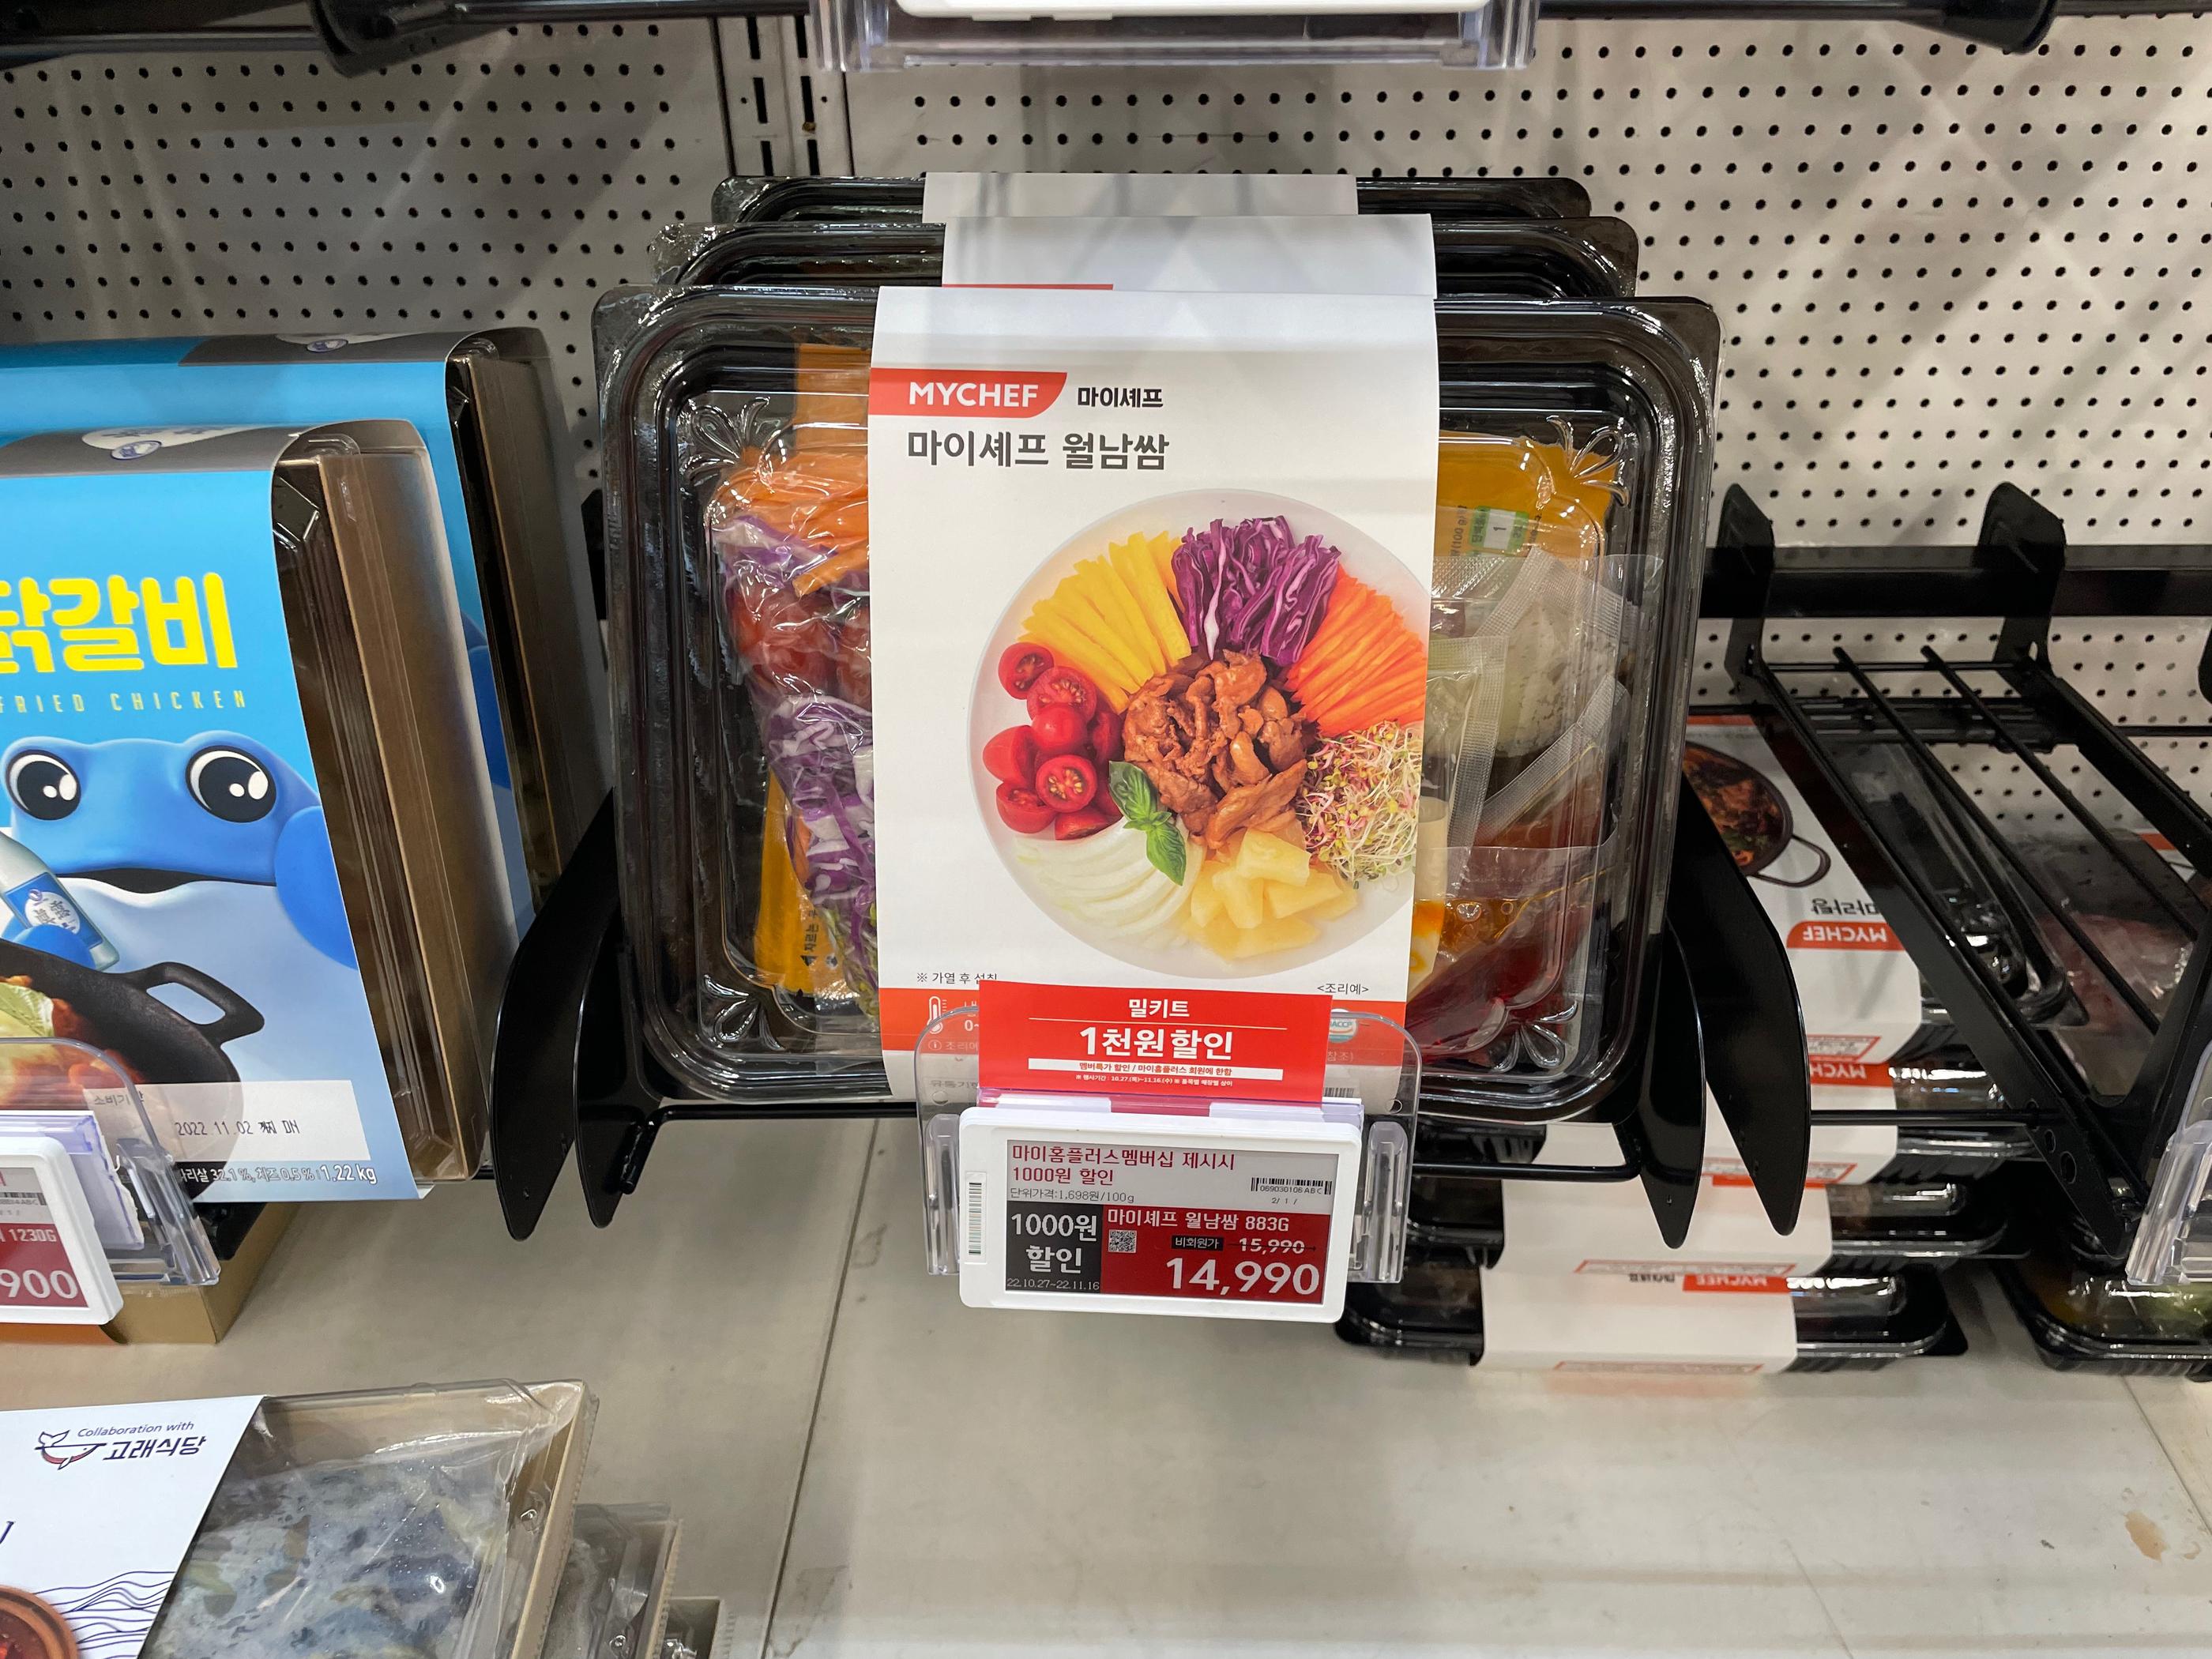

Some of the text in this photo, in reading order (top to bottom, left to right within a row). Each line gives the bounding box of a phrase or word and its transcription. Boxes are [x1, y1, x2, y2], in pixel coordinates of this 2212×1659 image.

[908, 382, 1039, 408] MYCHEF
[1078, 386, 1164, 408] 마이셰프
[908, 429, 1171, 471] 마이셰프 월남쌈
[110, 690, 246, 711] CHICKEN
[1803, 925, 1887, 942] MYCHEF
[932, 972, 955, 984] 가열
[960, 973, 971, 984] 후
[1317, 983, 1369, 995] <조리예>
[1128, 999, 1191, 1018] 밀키트
[1079, 1027, 1232, 1059] 1천원 할인
[1115, 1063, 1130, 1073] 할인
[1138, 1064, 1187, 1074] 마이홈플러스
[1810, 1063, 1867, 1078] MYCH
[1012, 1145, 1236, 1171] 마이홈플러스멤버십 제시시
[321, 1164, 356, 1182] 1.22
[356, 1162, 378, 1185] kg
[1012, 1167, 1115, 1187] 1000원 할인
[1010, 1213, 1097, 1242] 1000원
[1108, 1209, 1289, 1232] 마이셰프 월남쌈 883G
[8, 1228, 57, 1243] 1230G
[1175, 1236, 1220, 1249] 비회원가
[1239, 1237, 1305, 1255] 15,990
[1026, 1245, 1082, 1273] 할인
[1006, 1278, 1100, 1291] 22.10.27~22.11.16
[1166, 1258, 1320, 1296] 14,990
[77, 1421, 194, 1438] Collaboration with
[103, 1435, 206, 1460] 고래식당
